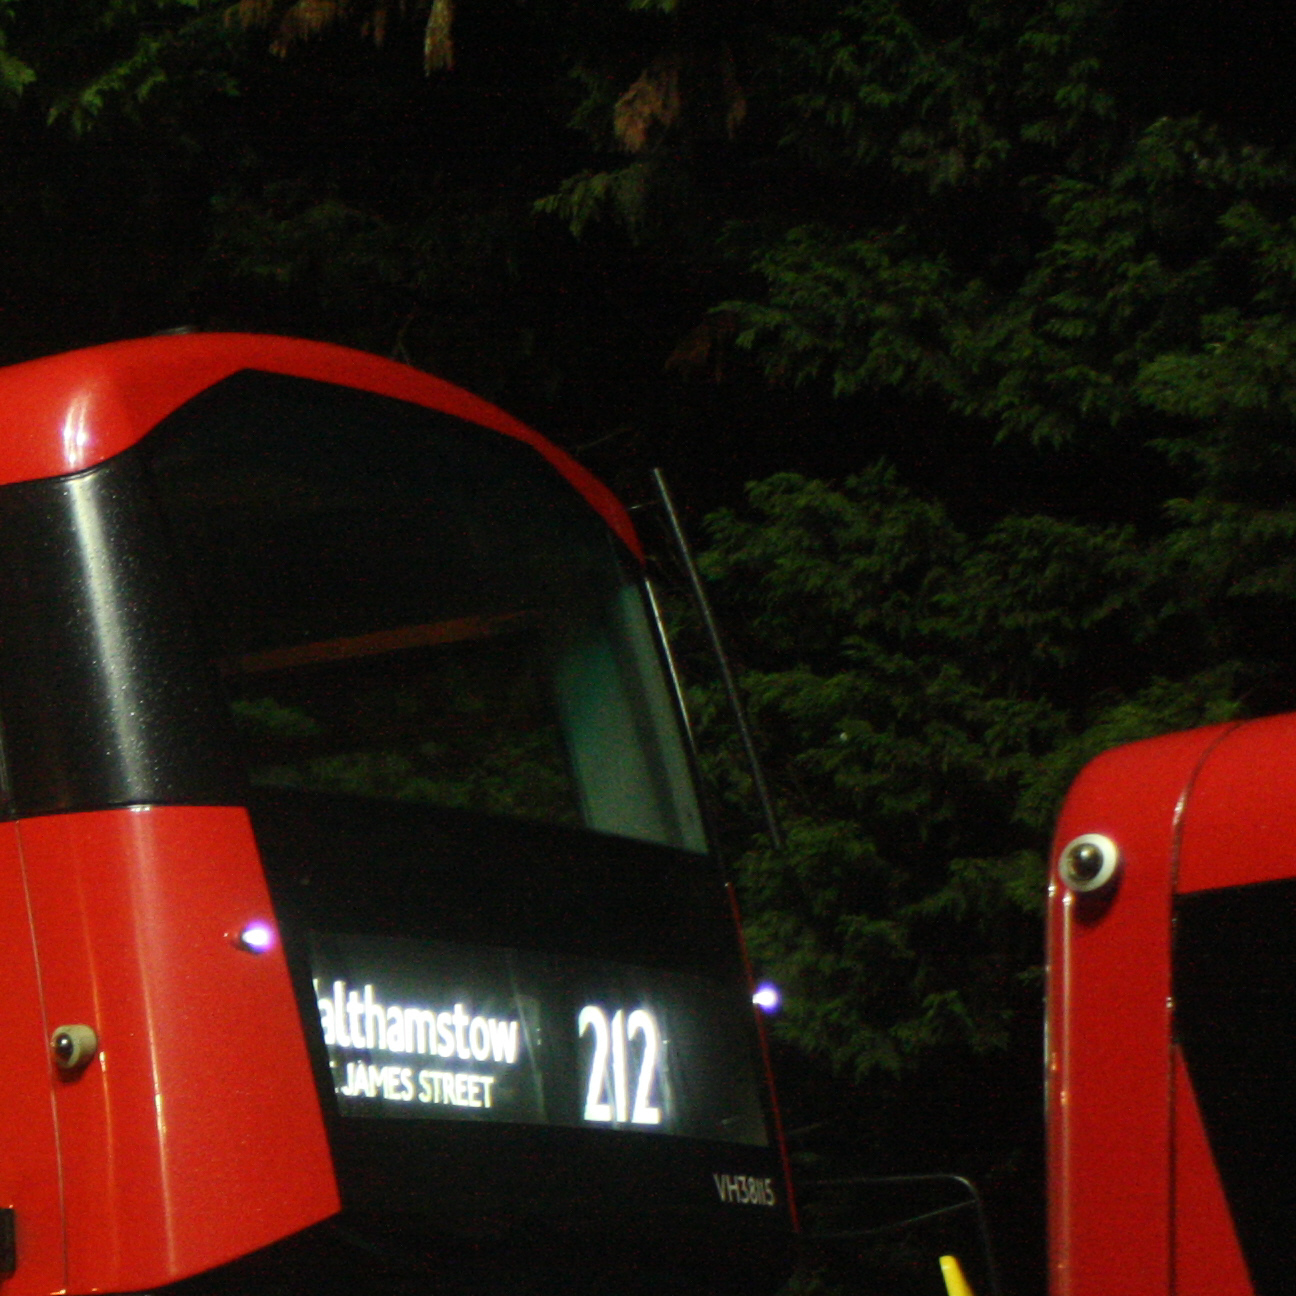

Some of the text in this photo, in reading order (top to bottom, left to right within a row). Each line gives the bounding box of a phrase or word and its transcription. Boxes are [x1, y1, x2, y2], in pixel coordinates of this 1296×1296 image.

[312, 978, 520, 1064] althamstow
[340, 1060, 416, 1101] JAMES
[418, 1069, 495, 1108] STREET
[577, 1004, 661, 1125] 212
